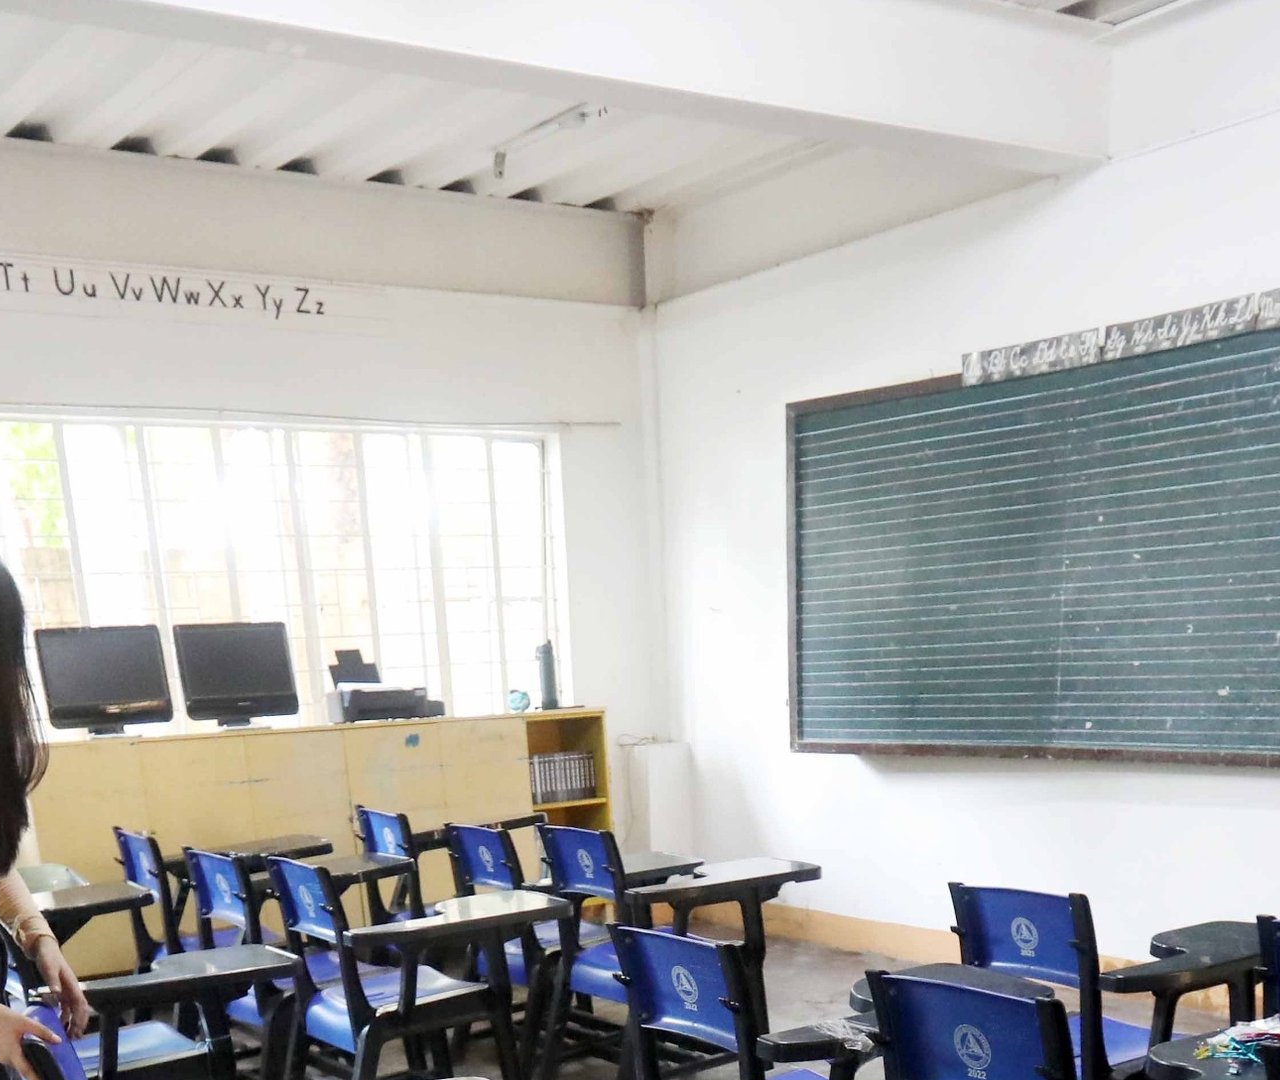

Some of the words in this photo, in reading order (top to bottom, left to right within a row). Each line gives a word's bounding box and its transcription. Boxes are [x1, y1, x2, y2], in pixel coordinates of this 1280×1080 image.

[53, 267, 97, 298] Uu
[109, 271, 143, 301] Vv
[150, 275, 200, 305] Ww
[205, 279, 245, 309] Xx
[255, 284, 283, 320] Yy
[294, 287, 325, 316] Zz
